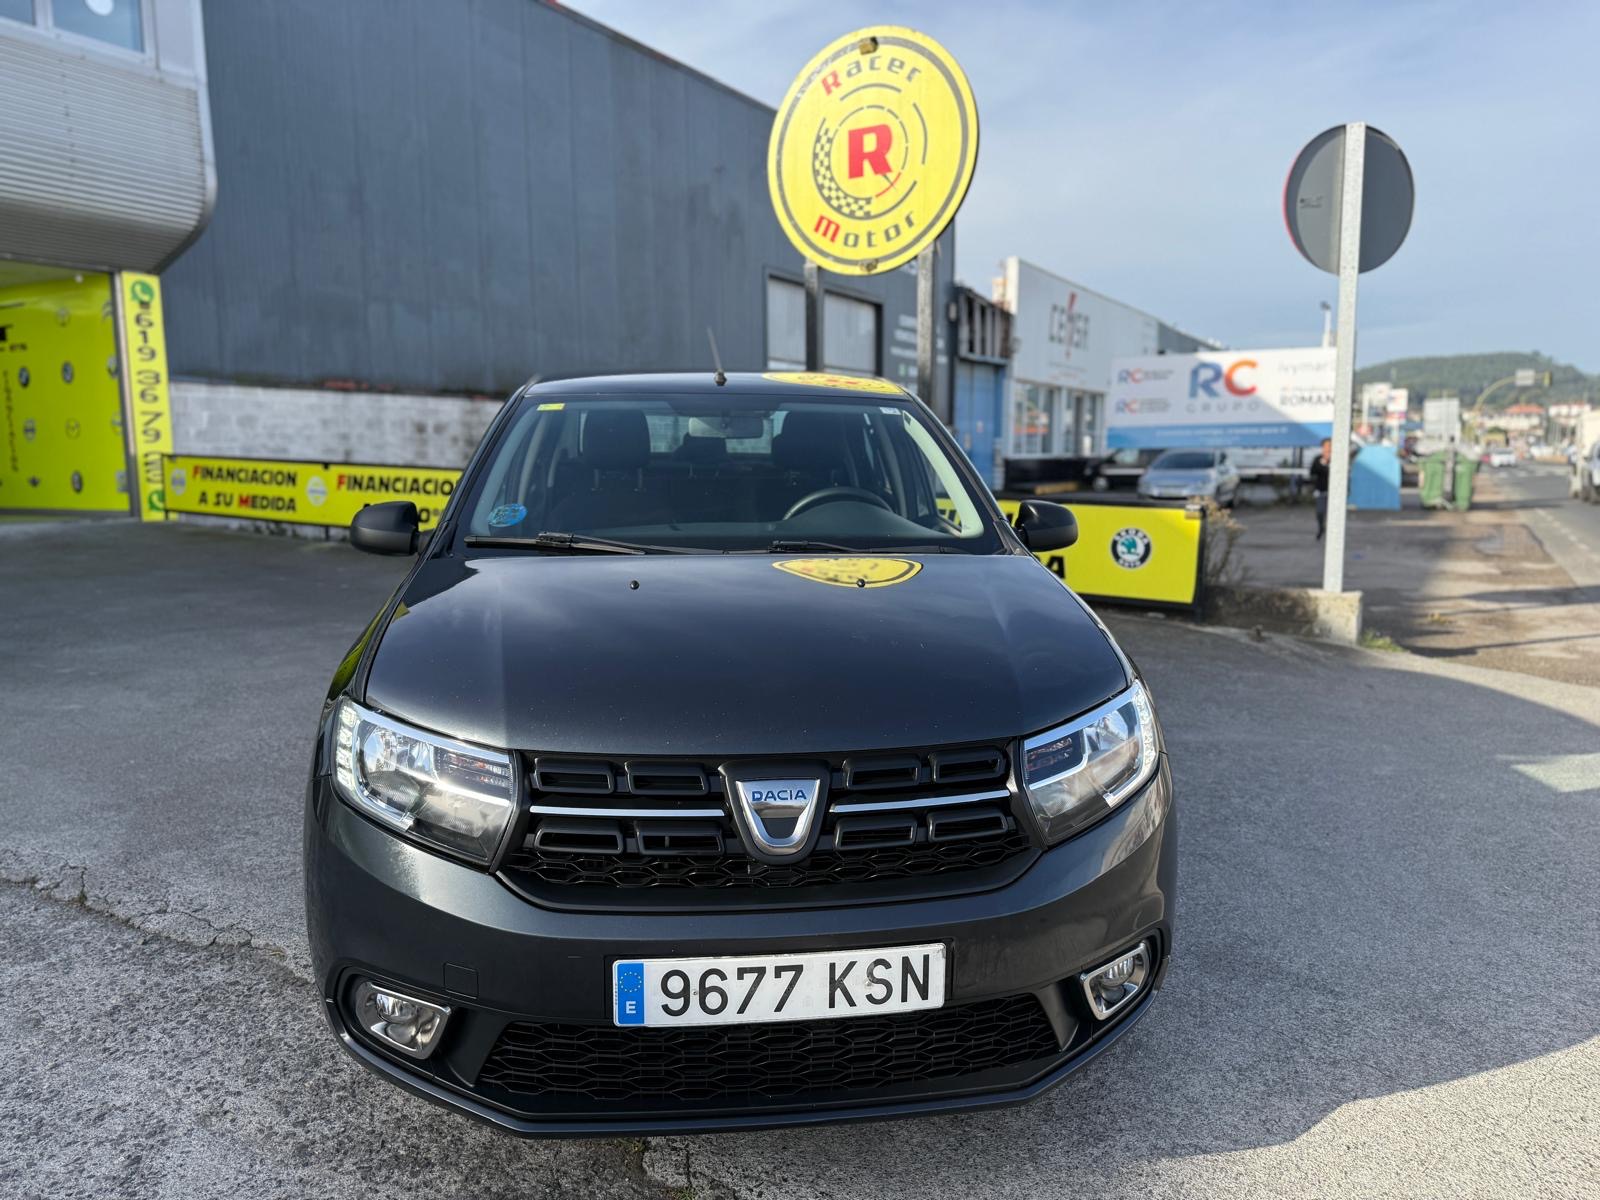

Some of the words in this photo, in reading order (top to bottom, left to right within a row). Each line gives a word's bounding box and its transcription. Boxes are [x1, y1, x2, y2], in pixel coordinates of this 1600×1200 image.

[820, 54, 923, 96] Racer
[848, 123, 893, 180] R
[813, 210, 915, 249] Motor
[133, 312, 157, 362] 619
[137, 370, 161, 403] 36
[1188, 359, 1258, 398] RC
[1185, 401, 1263, 414] GRUPO
[141, 411, 163, 443] 79
[192, 465, 297, 487] FINANCIACION
[336, 474, 458, 496] FINANCIACIO
[198, 491, 208, 505] A
[214, 492, 233, 507] SU
[239, 494, 297, 512] MEDIDA
[751, 788, 808, 802] DACIA
[659, 964, 805, 1018] 9677
[827, 953, 931, 1010] KSN
[625, 1000, 637, 1014] E
